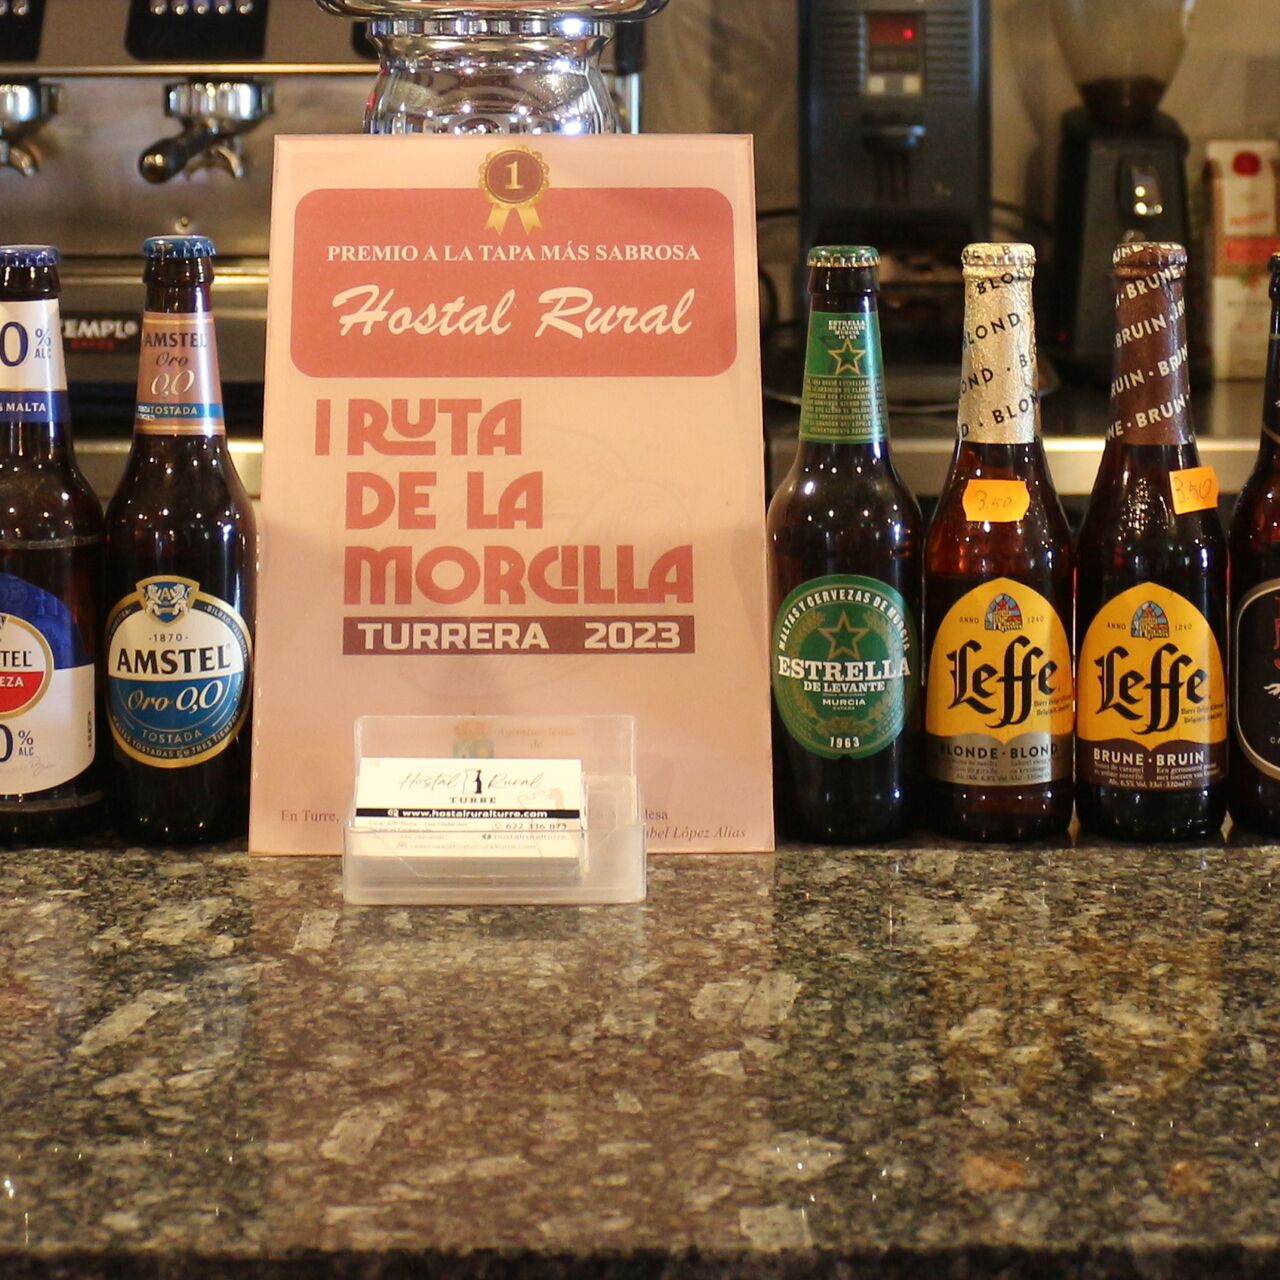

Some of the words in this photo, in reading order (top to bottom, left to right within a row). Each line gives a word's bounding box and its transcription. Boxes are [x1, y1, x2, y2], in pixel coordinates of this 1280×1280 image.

[327, 246, 419, 262] PREMIO
[422, 246, 436, 261] A
[443, 246, 473, 261] LA
[478, 245, 536, 261] TAPA
[541, 240, 589, 261] MÁS
[595, 244, 702, 261] SABROSA
[332, 284, 516, 337] Hostal
[535, 286, 697, 339] Rural
[61, 320, 138, 339] EMPLO
[1114, 313, 1168, 349] BRUIN
[144, 332, 207, 348] AMSTEL
[156, 352, 188, 367] Oro
[6, 402, 46, 412] MALTA
[150, 405, 198, 415] TOSTADA
[315, 399, 331, 456] I
[347, 398, 522, 456] RUTA
[346, 472, 437, 530] DE
[467, 472, 544, 530] LA
[344, 545, 694, 605] MORCILLA
[779, 610, 801, 651] MALTAS
[798, 600, 807, 614] Y
[807, 589, 870, 609] CERVEZAS
[873, 597, 888, 612] DE
[886, 604, 911, 651] MURCIA
[154, 633, 183, 642] 1870
[357, 622, 549, 650] TURRERA
[584, 622, 680, 650] 2023
[117, 646, 231, 675] AMSTEL
[778, 655, 911, 682] ESTRELLA
[803, 680, 821, 693] DE
[824, 681, 886, 693] LEVANTE
[946, 635, 1058, 730] Leffe
[1093, 642, 1208, 736] Leffe
[127, 688, 170, 711] Oro
[822, 699, 867, 707] MURCIA
[142, 728, 203, 748] TOSTADA
[830, 736, 861, 749] 1963
[939, 743, 998, 760] BLONDE
[1010, 743, 1058, 760] BLOND
[1093, 748, 1144, 766] BRUNE
[1156, 750, 1205, 766] BRUIN
[281, 809, 298, 822] En
[303, 809, 340, 824] Turre,
[673, 825, 710, 841] López
